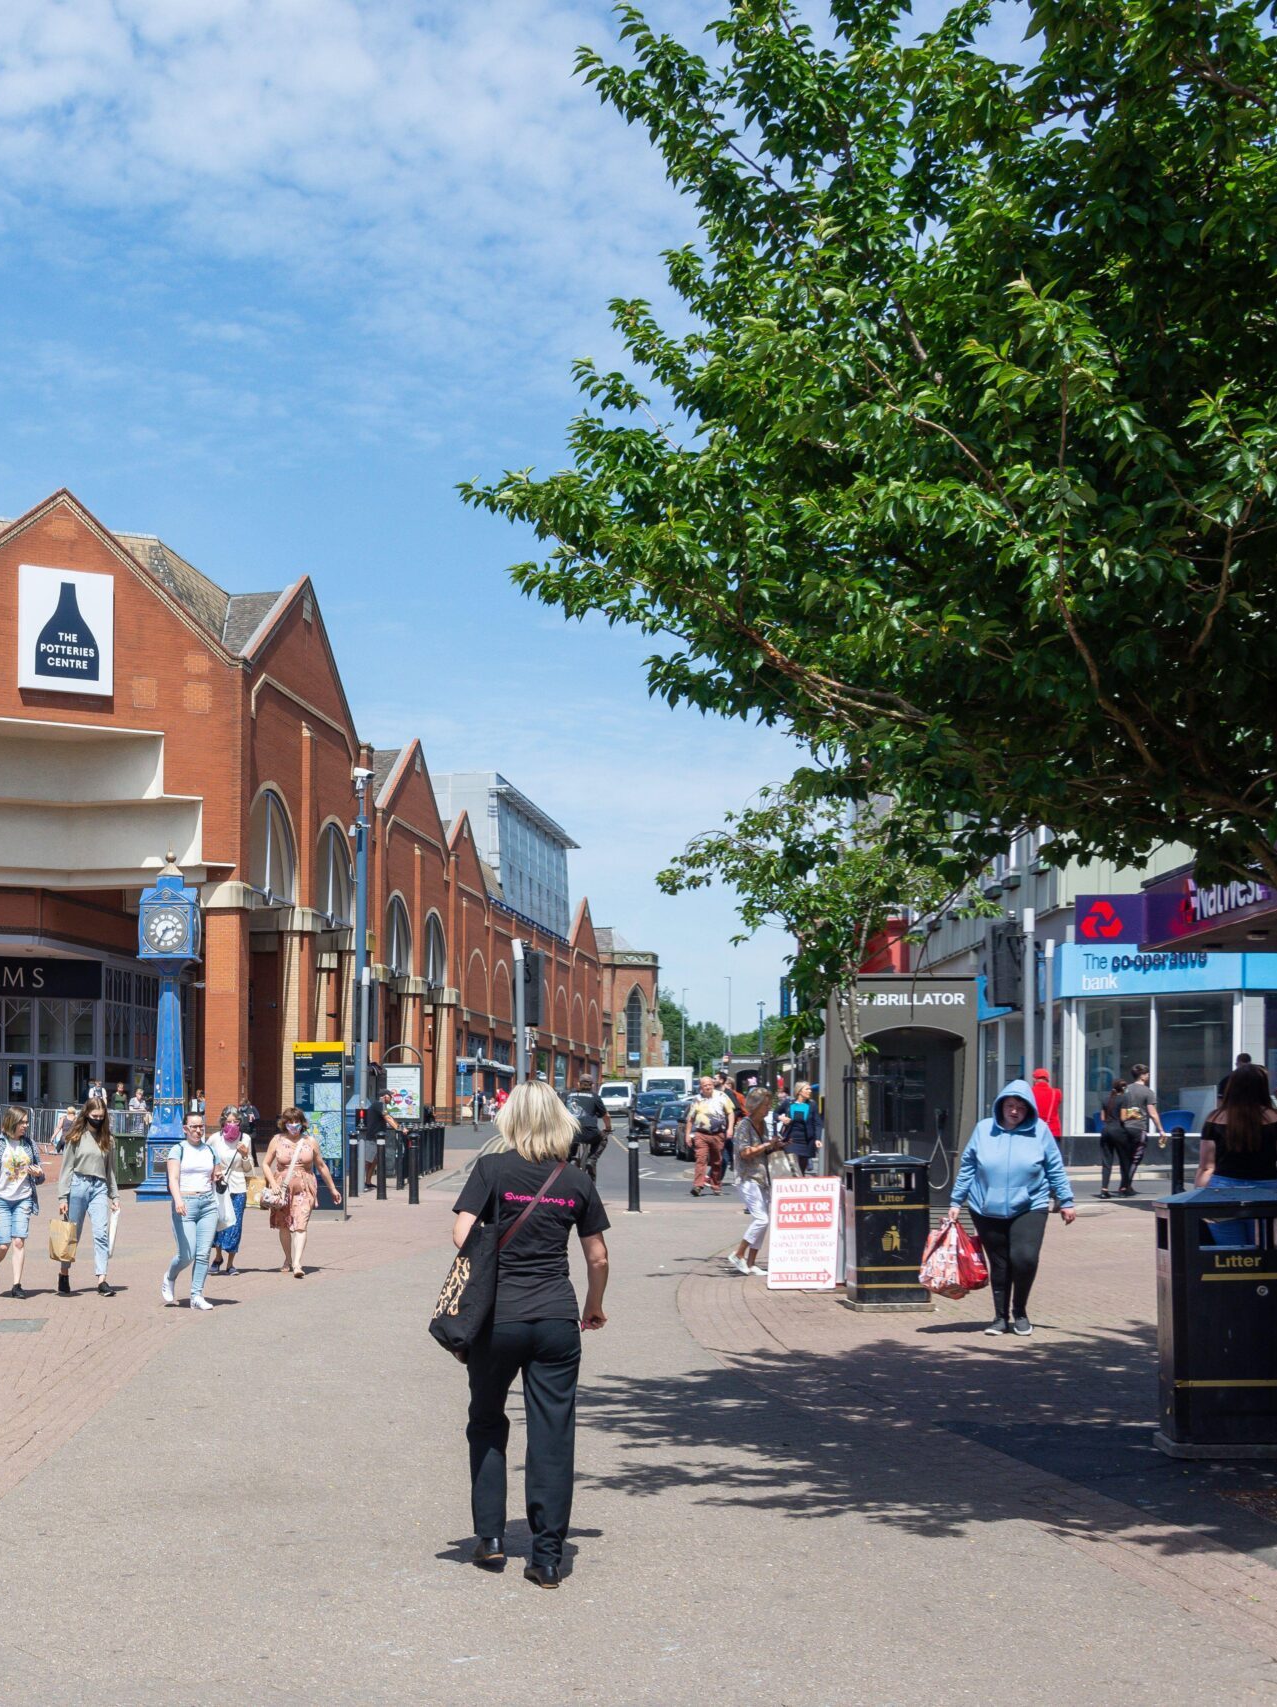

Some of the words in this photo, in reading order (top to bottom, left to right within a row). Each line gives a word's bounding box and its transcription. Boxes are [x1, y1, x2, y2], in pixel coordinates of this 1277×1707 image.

[57, 632, 78, 643] THE
[40, 643, 95, 658] POTTERIES
[47, 657, 88, 669] CENTRE
[1083, 953, 1108, 971] The
[1082, 974, 1118, 991] bank
[776, 1184, 809, 1193] HANLEY
[504, 1191, 566, 1206] Supedrug
[878, 1194, 906, 1203] Litter
[780, 1202, 807, 1212] OPEN
[809, 1202, 830, 1211] FOR
[778, 1213, 832, 1223] TAKEAWAYS
[1214, 1254, 1262, 1268] Litter
